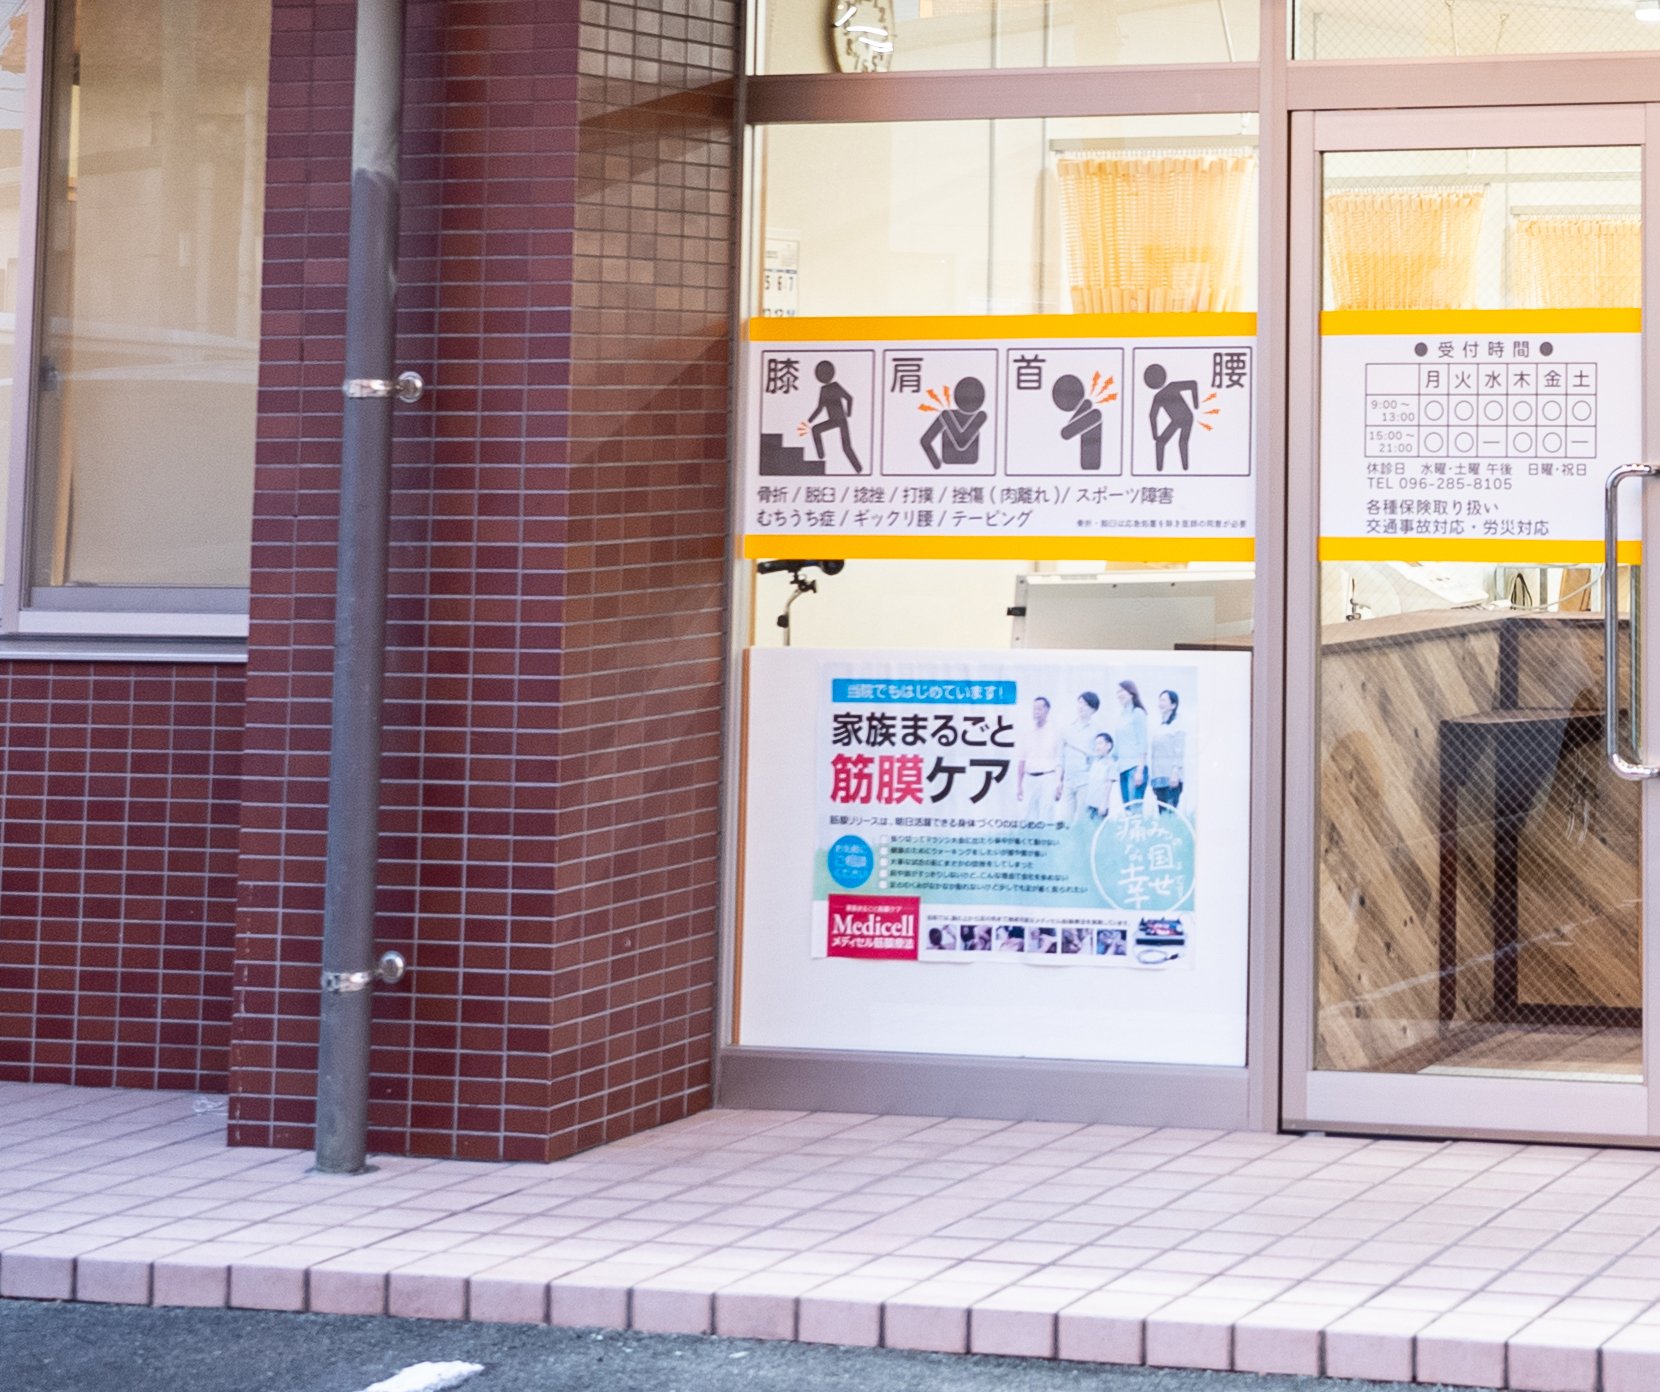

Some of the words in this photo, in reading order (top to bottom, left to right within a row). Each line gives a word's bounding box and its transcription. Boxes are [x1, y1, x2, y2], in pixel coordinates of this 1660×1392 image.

[1438, 340, 1530, 358] 受付時間
[765, 358, 800, 394] 膝
[891, 357, 924, 393] 肩
[1013, 354, 1046, 390] 首
[1212, 352, 1247, 390] 腰
[1425, 370, 1440, 388] 月
[1454, 371, 1472, 388] 火
[1484, 370, 1502, 388] 水
[1513, 370, 1531, 388] 木
[1544, 369, 1562, 388] 金
[1572, 370, 1591, 388] 土
[1381, 412, 1415, 422] 13:00
[1378, 443, 1413, 453] 21:00
[1367, 462, 1405, 475] 休診日
[1486, 463, 1513, 476] 午後
[1367, 477, 1393, 489] TEL
[1399, 477, 1513, 490] 096-285-8105
[757, 486, 788, 504] 骨折
[805, 486, 836, 504] 脱臼
[853, 486, 886, 504] 捻挫
[902, 486, 934, 504] 打撲
[1366, 499, 1499, 516] 各種保険取り扱い
[757, 509, 836, 527] むちうち症
[853, 509, 934, 527] ギックリ腰
[832, 712, 1015, 748] 家族まるごと
[830, 753, 1011, 805] 筋膜ケア
[832, 913, 915, 937] Medicell
